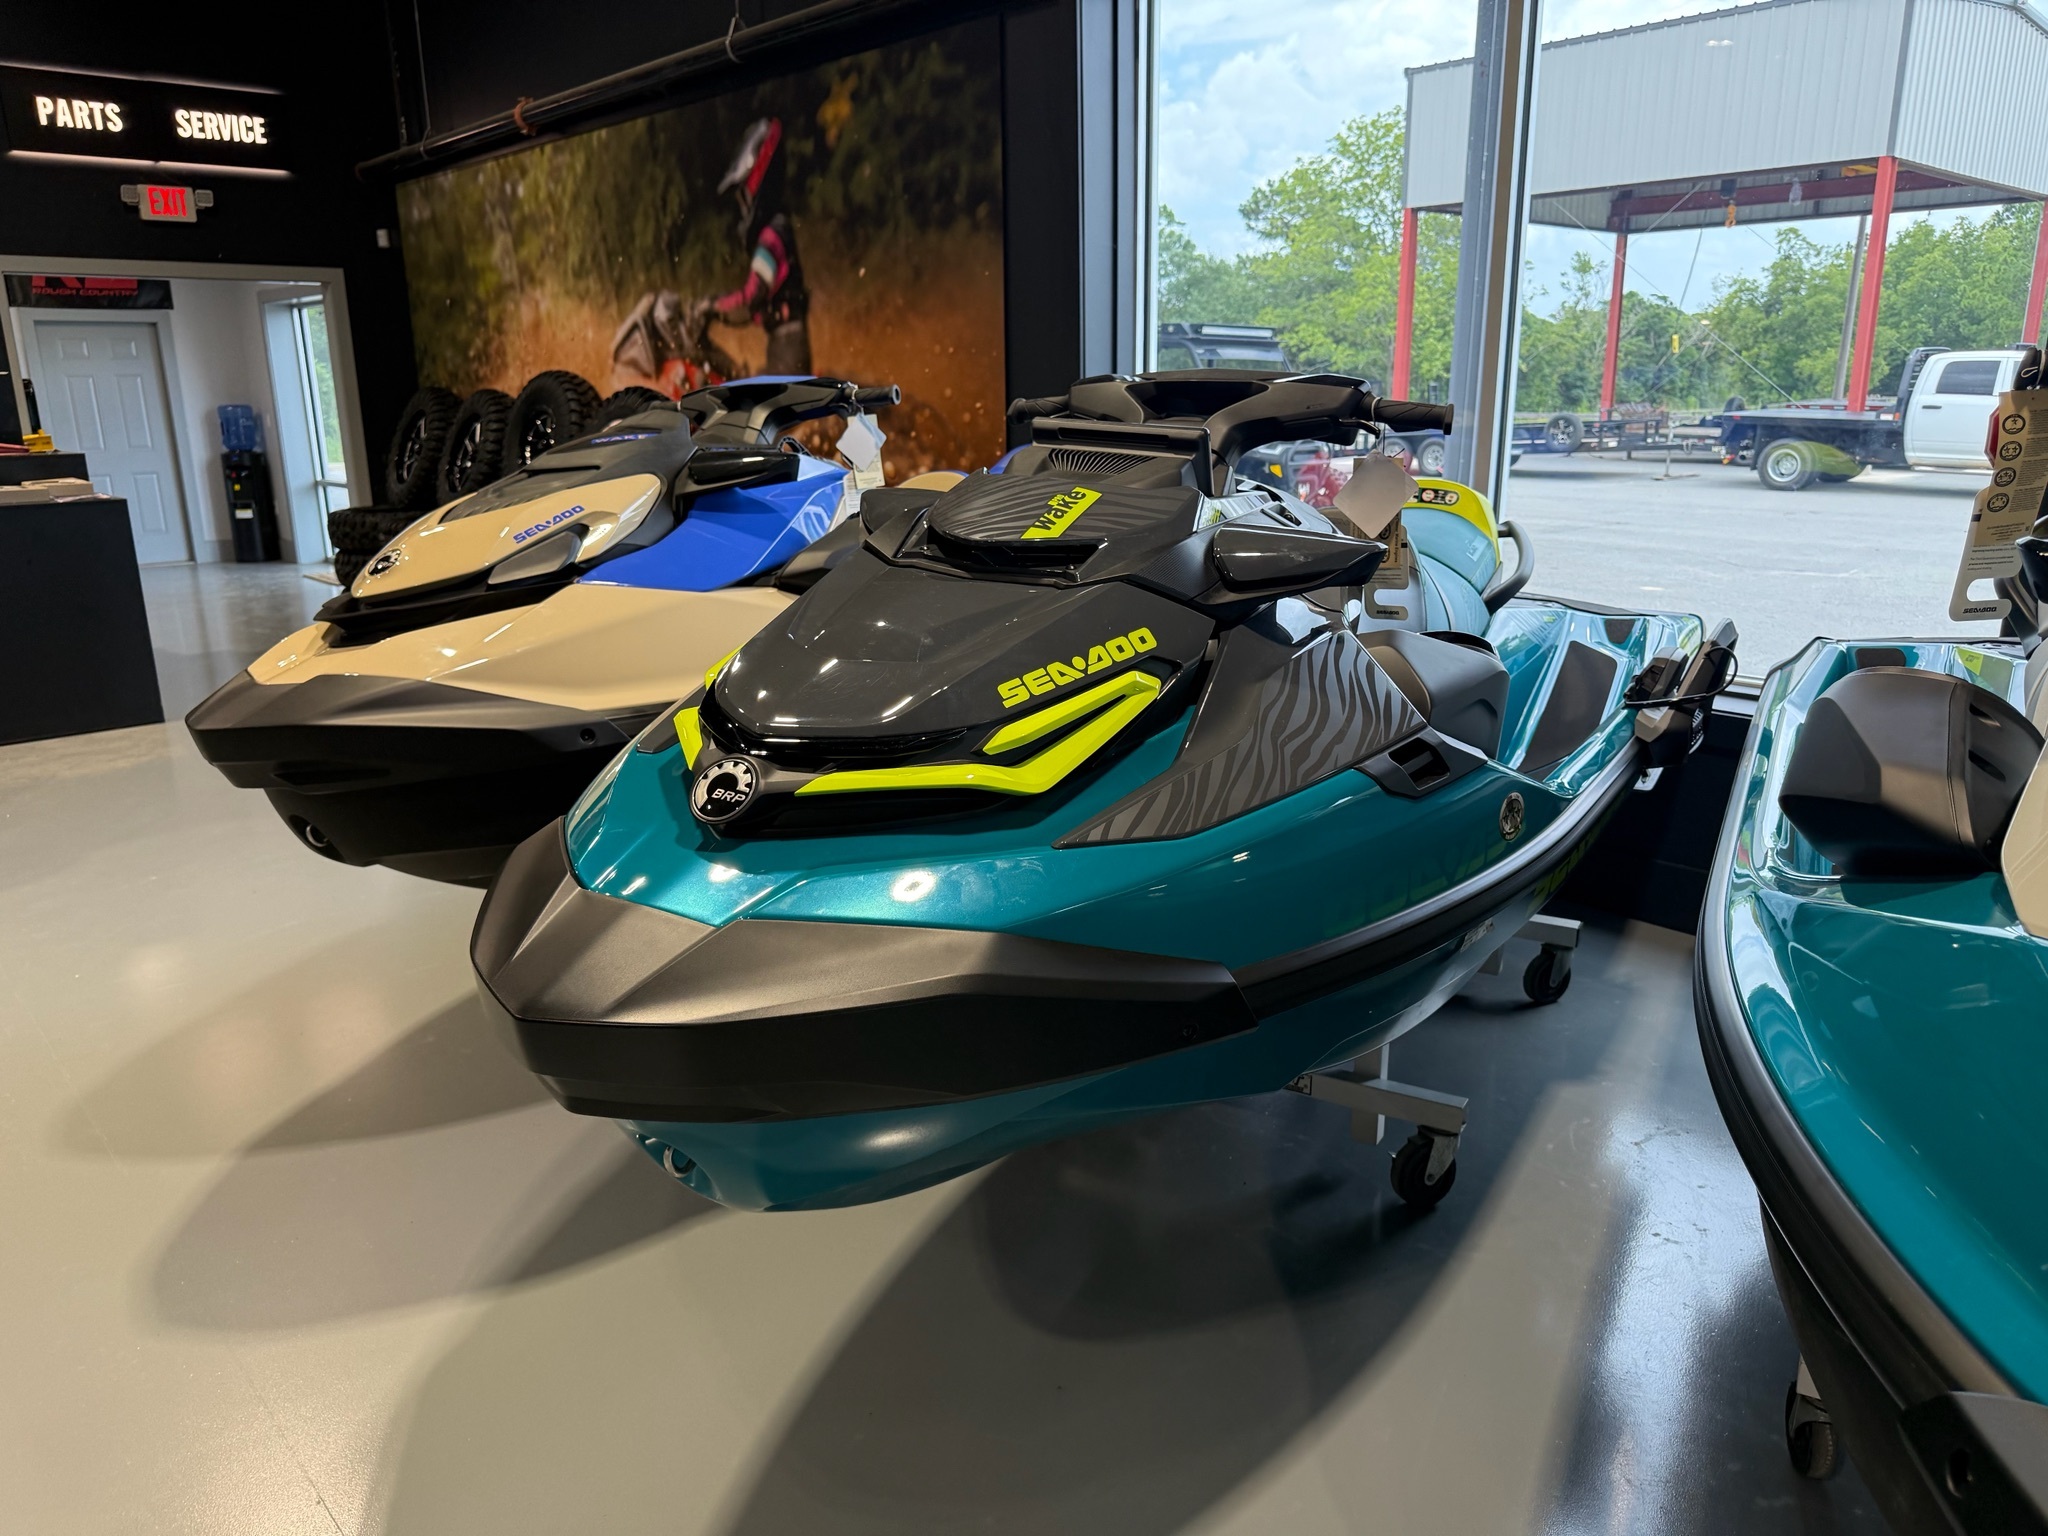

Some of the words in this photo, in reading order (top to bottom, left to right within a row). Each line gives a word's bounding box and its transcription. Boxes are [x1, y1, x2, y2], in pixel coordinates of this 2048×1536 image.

[35, 96, 124, 133] PARTS
[174, 109, 268, 145] SERVICE
[147, 186, 188, 217] EXIT
[32, 286, 77, 296] ROUGH
[79, 288, 138, 297] COUNTRY
[711, 788, 746, 803] BRP
